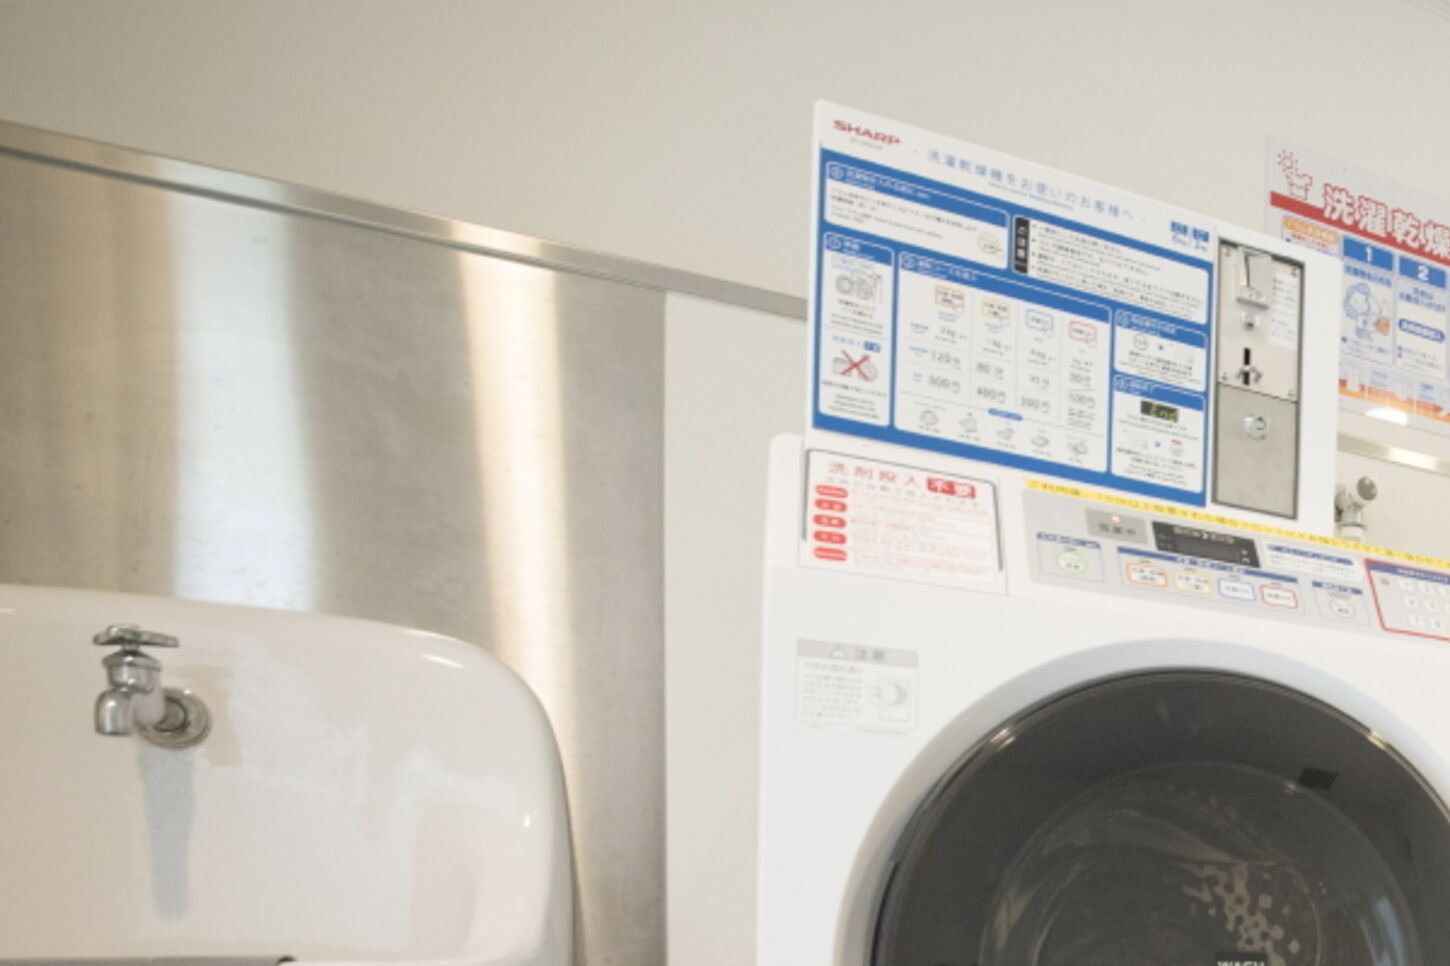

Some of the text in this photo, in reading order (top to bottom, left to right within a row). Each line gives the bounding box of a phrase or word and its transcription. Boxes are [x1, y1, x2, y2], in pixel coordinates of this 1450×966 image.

[832, 119, 901, 145] SHARP
[1364, 246, 1373, 262] 1
[1416, 265, 1430, 281] 2
